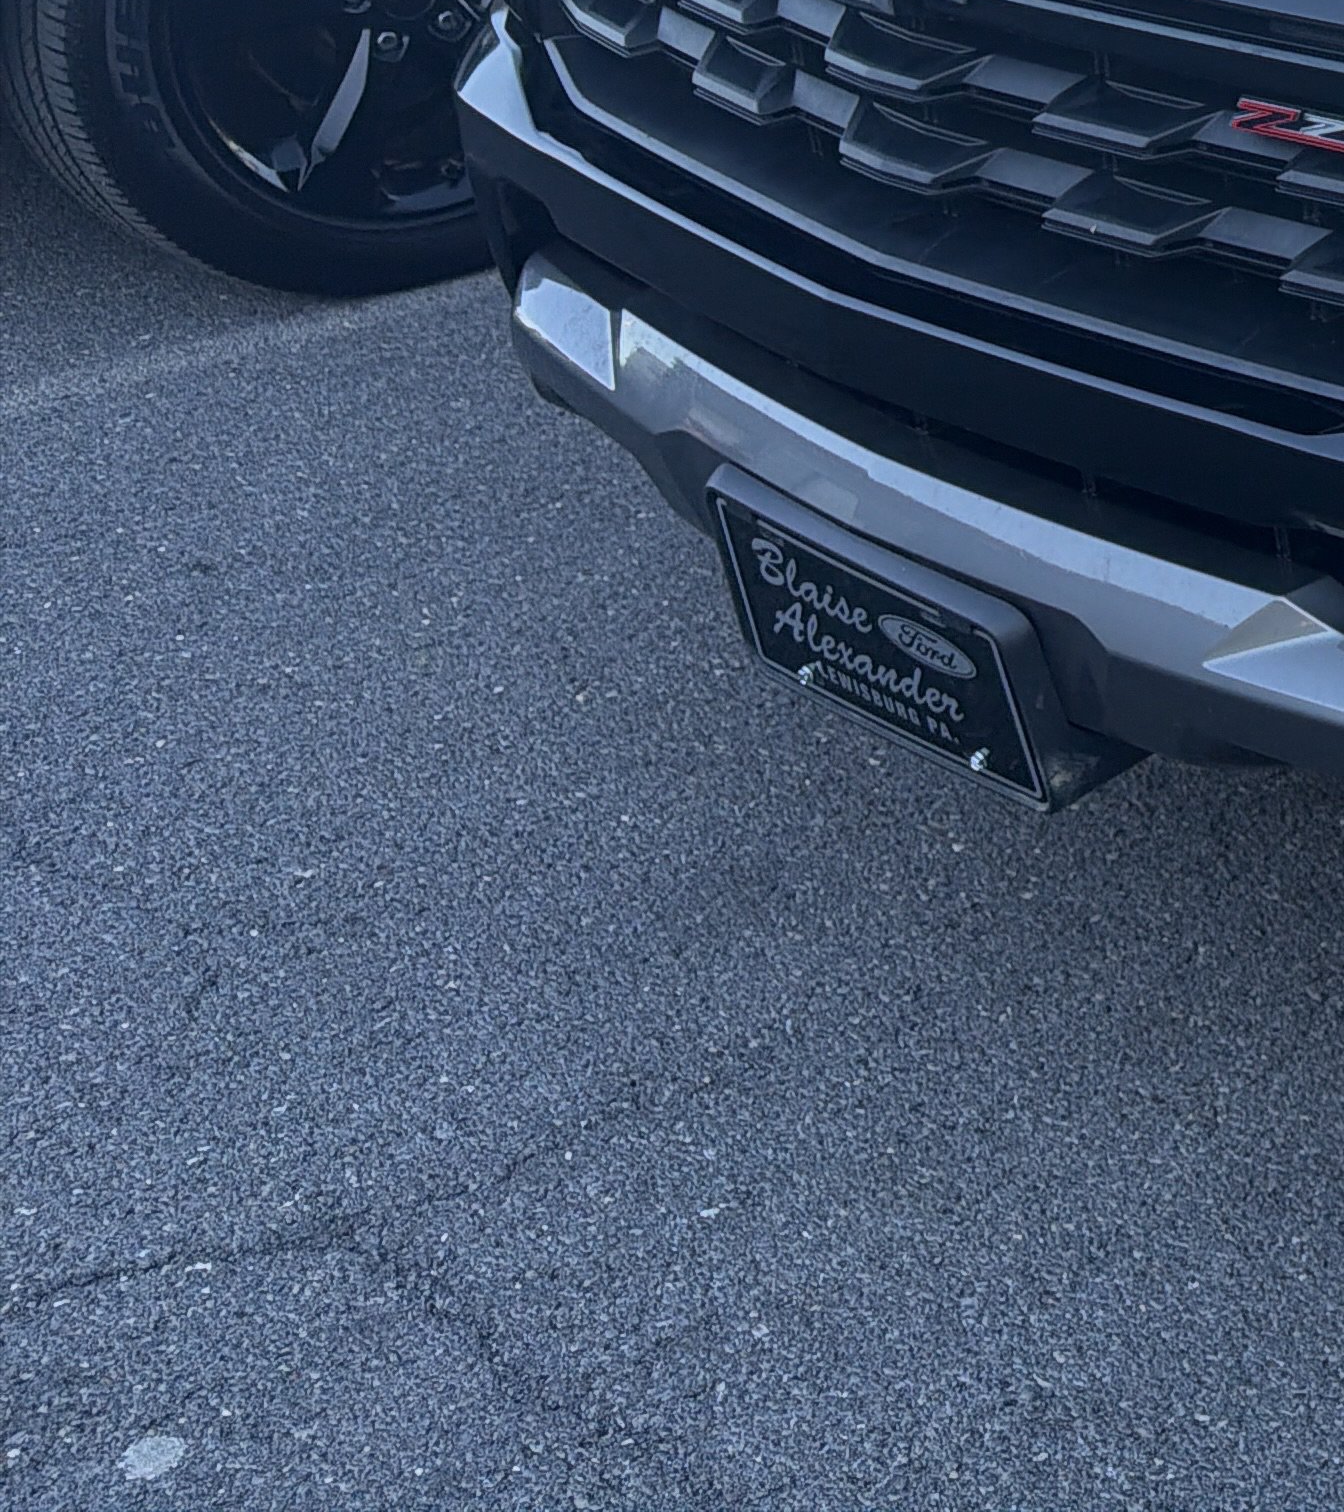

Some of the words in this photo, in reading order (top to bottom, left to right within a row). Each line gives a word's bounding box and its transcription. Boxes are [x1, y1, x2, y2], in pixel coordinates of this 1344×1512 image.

[752, 538, 873, 634] Blaise
[774, 602, 965, 722] Alexander
[898, 624, 960, 671] Ford
[812, 661, 922, 729] LEWISBURG
